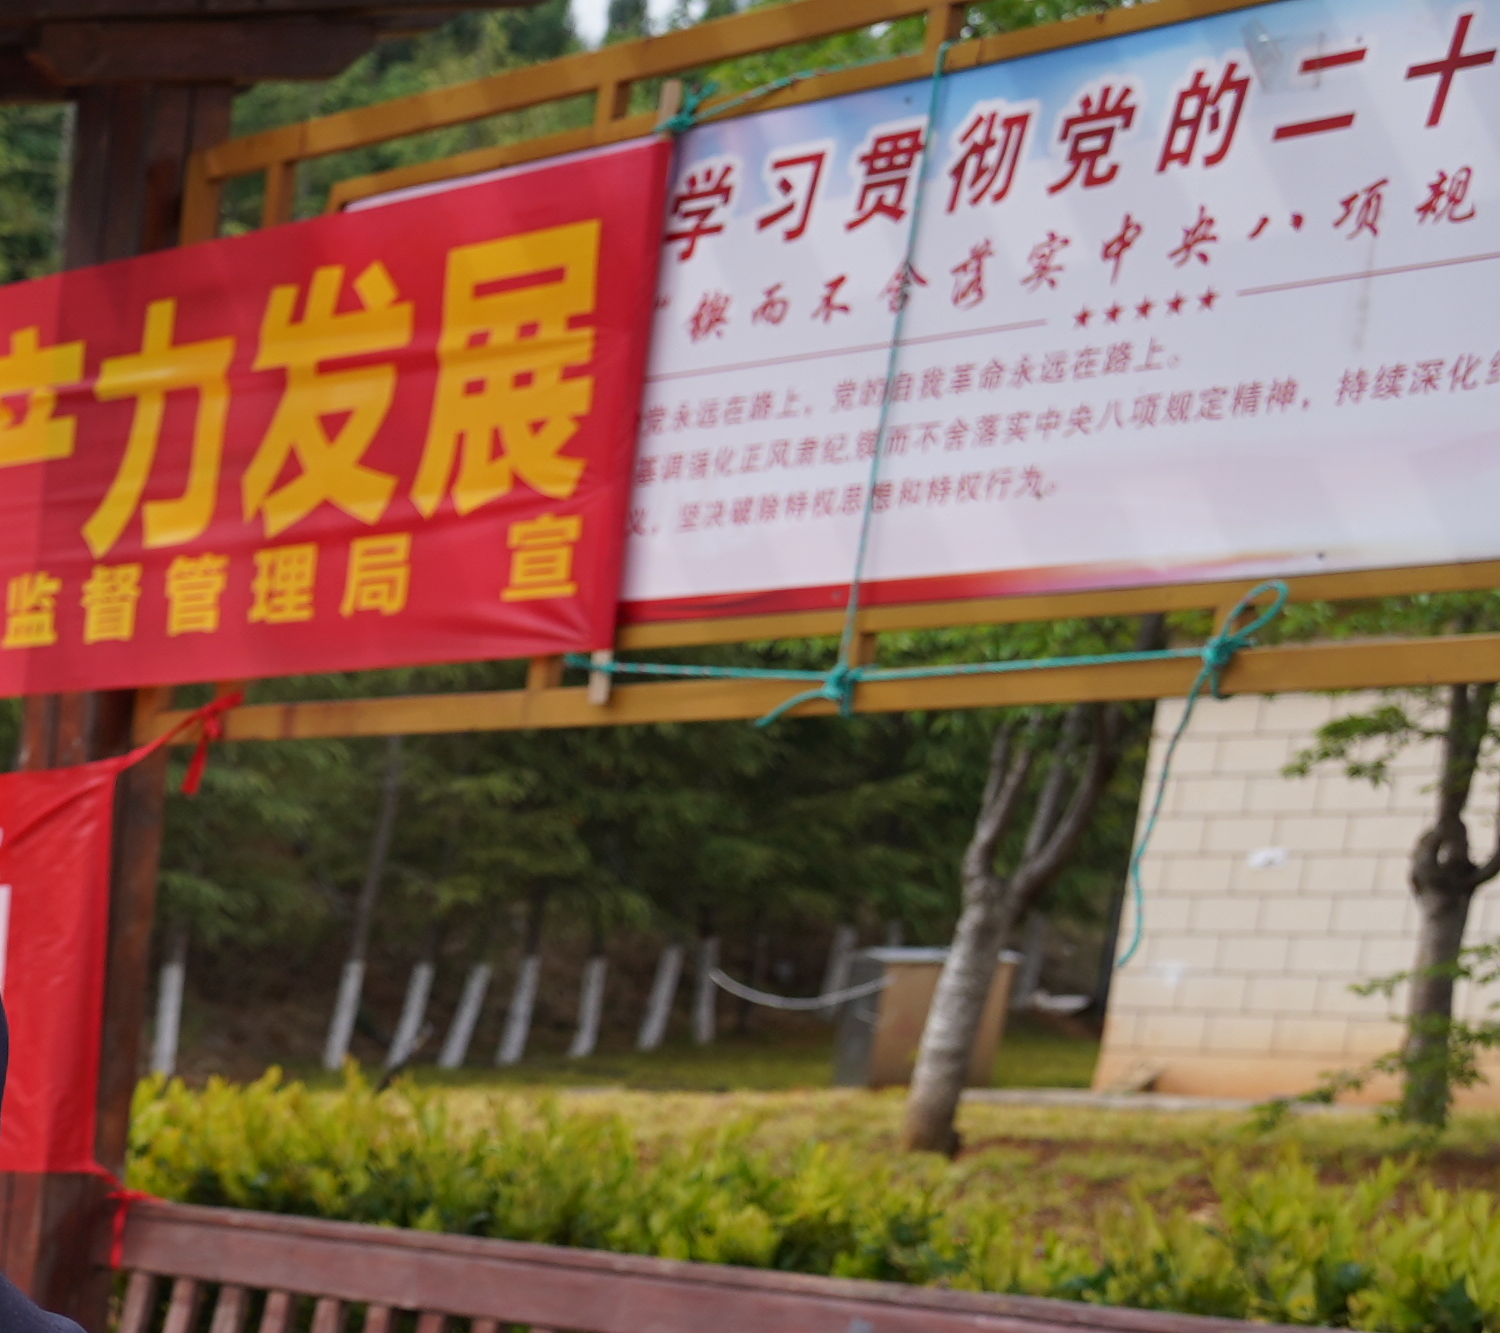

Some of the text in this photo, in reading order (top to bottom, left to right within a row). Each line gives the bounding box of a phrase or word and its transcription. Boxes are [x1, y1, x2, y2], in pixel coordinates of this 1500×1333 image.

[666, 13, 1498, 262] 学习贯彻党的二十
[502, 514, 582, 602] 宣
